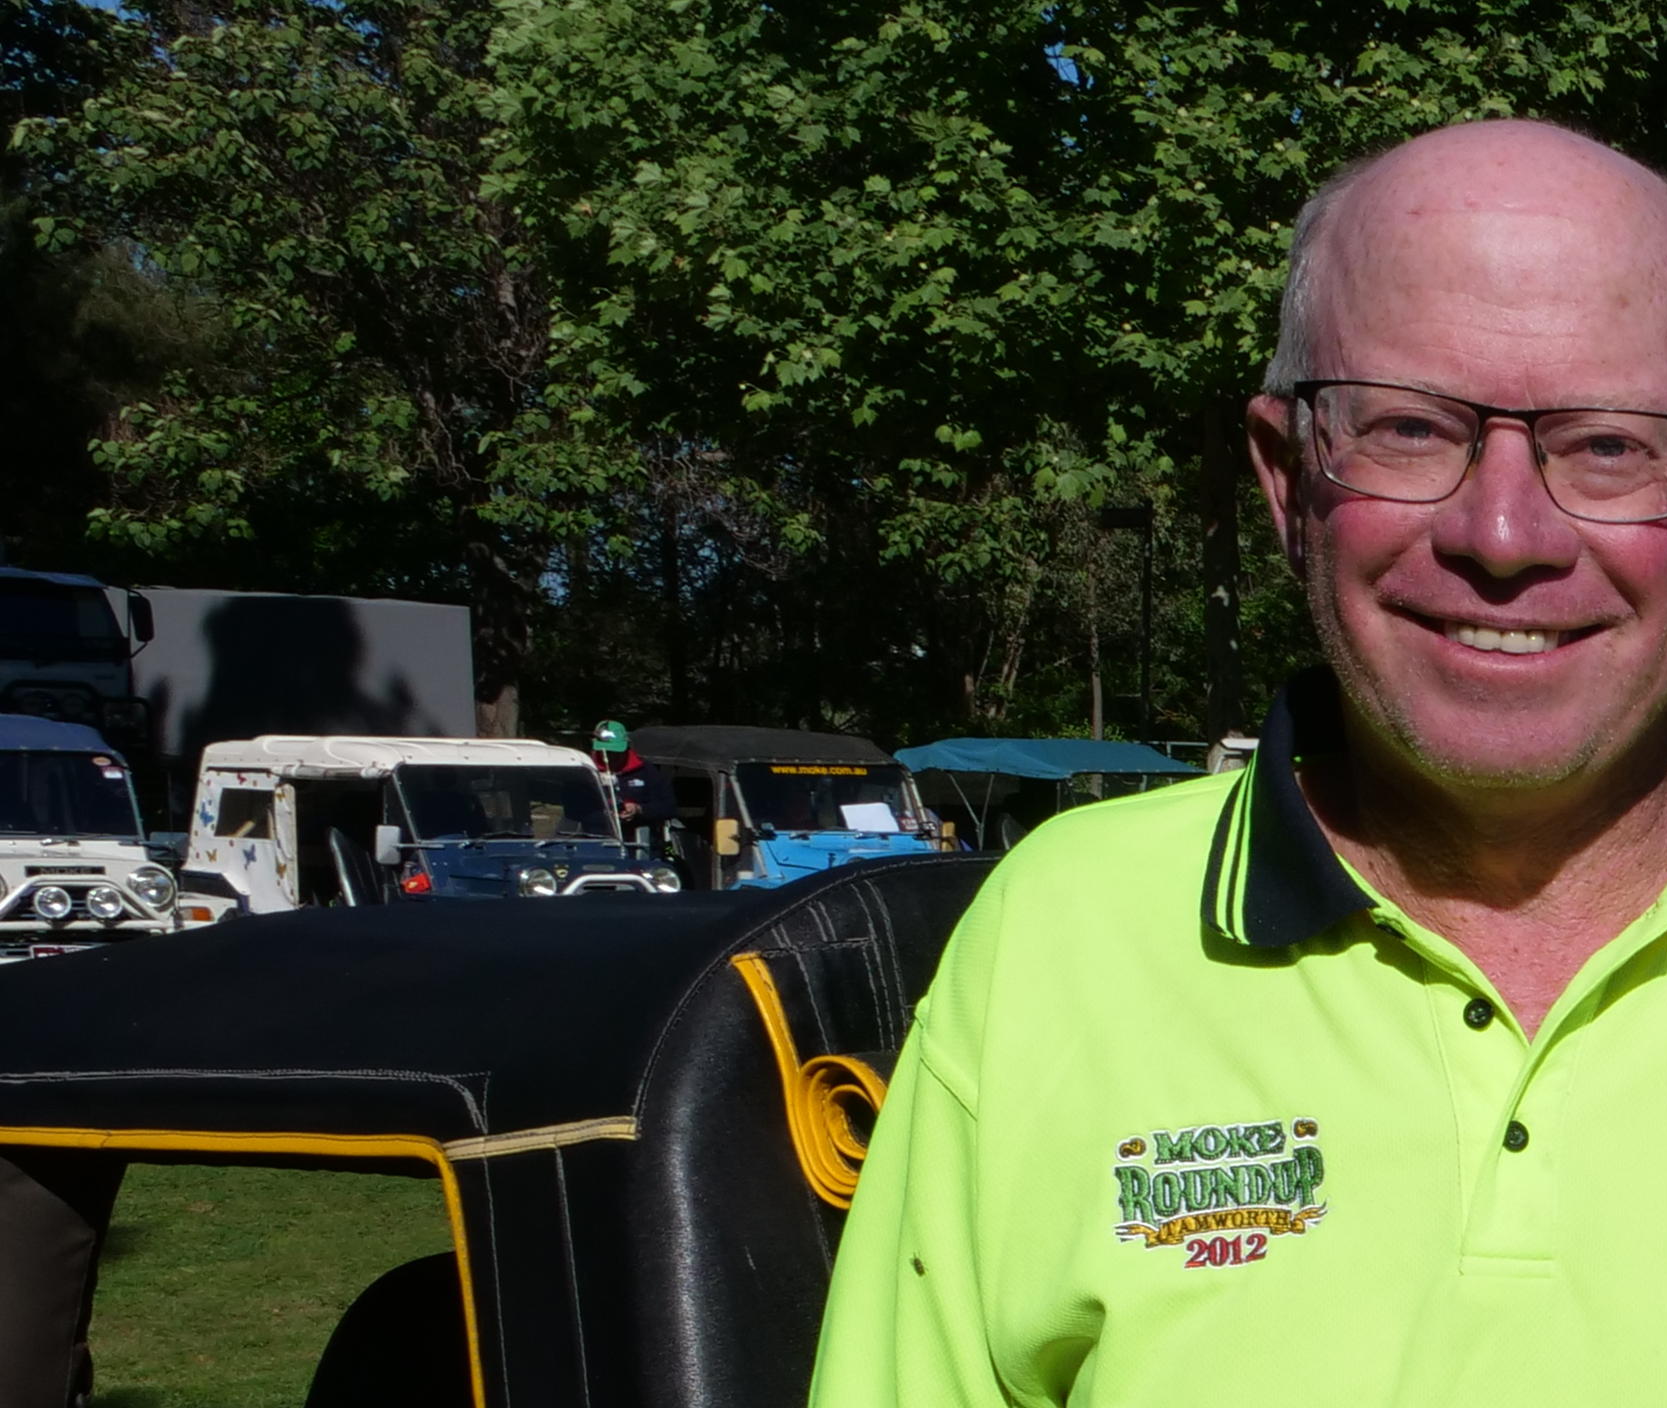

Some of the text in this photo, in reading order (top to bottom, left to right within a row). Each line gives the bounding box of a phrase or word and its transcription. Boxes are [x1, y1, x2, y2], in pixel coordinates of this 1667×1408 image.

[770, 765, 868, 776] www.moke.com.au
[1153, 1121, 1287, 1165] MOKE
[1114, 1146, 1324, 1226] ROUNDUP
[1161, 1209, 1290, 1236] TAMWORTH
[1184, 1232, 1269, 1269] 2012
